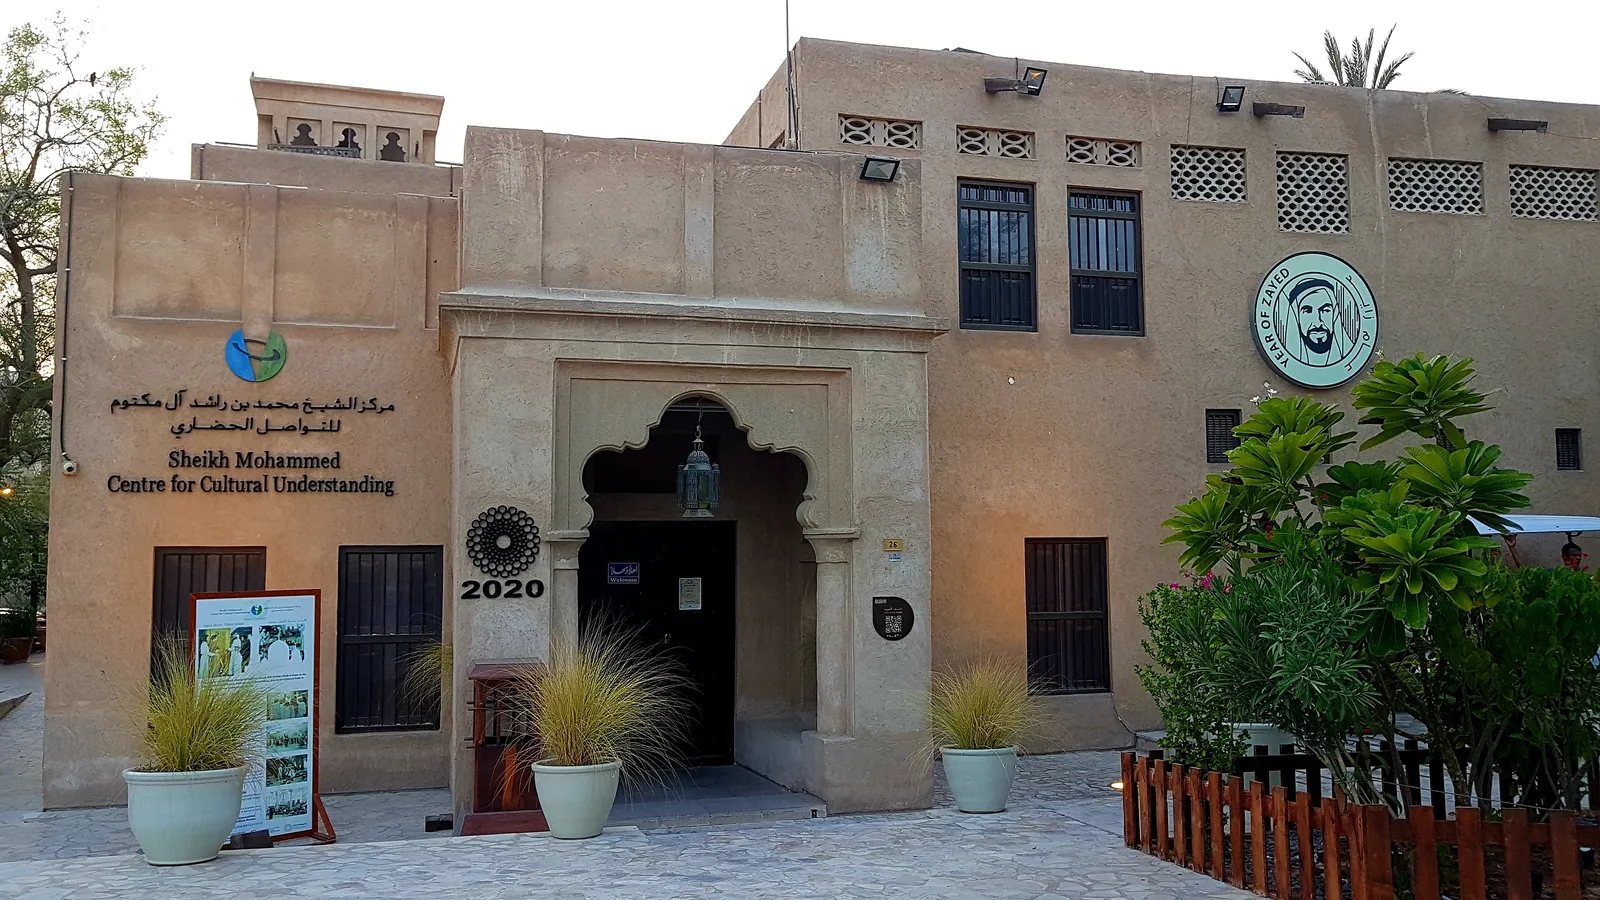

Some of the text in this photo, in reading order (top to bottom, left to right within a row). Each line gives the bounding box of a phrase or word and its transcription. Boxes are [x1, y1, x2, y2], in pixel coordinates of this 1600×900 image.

[1260, 268, 1290, 368] YEAR OF ZAYED
[110, 389, 395, 414] مركز الشيخ محمد بن راشد آل مكتوم
[170, 417, 341, 439] للتواصل الحضاري
[168, 449, 341, 469] Sheikh Mohammed
[107, 474, 395, 497] Centre for Cultural Understanding
[461, 579, 544, 599] 2020
